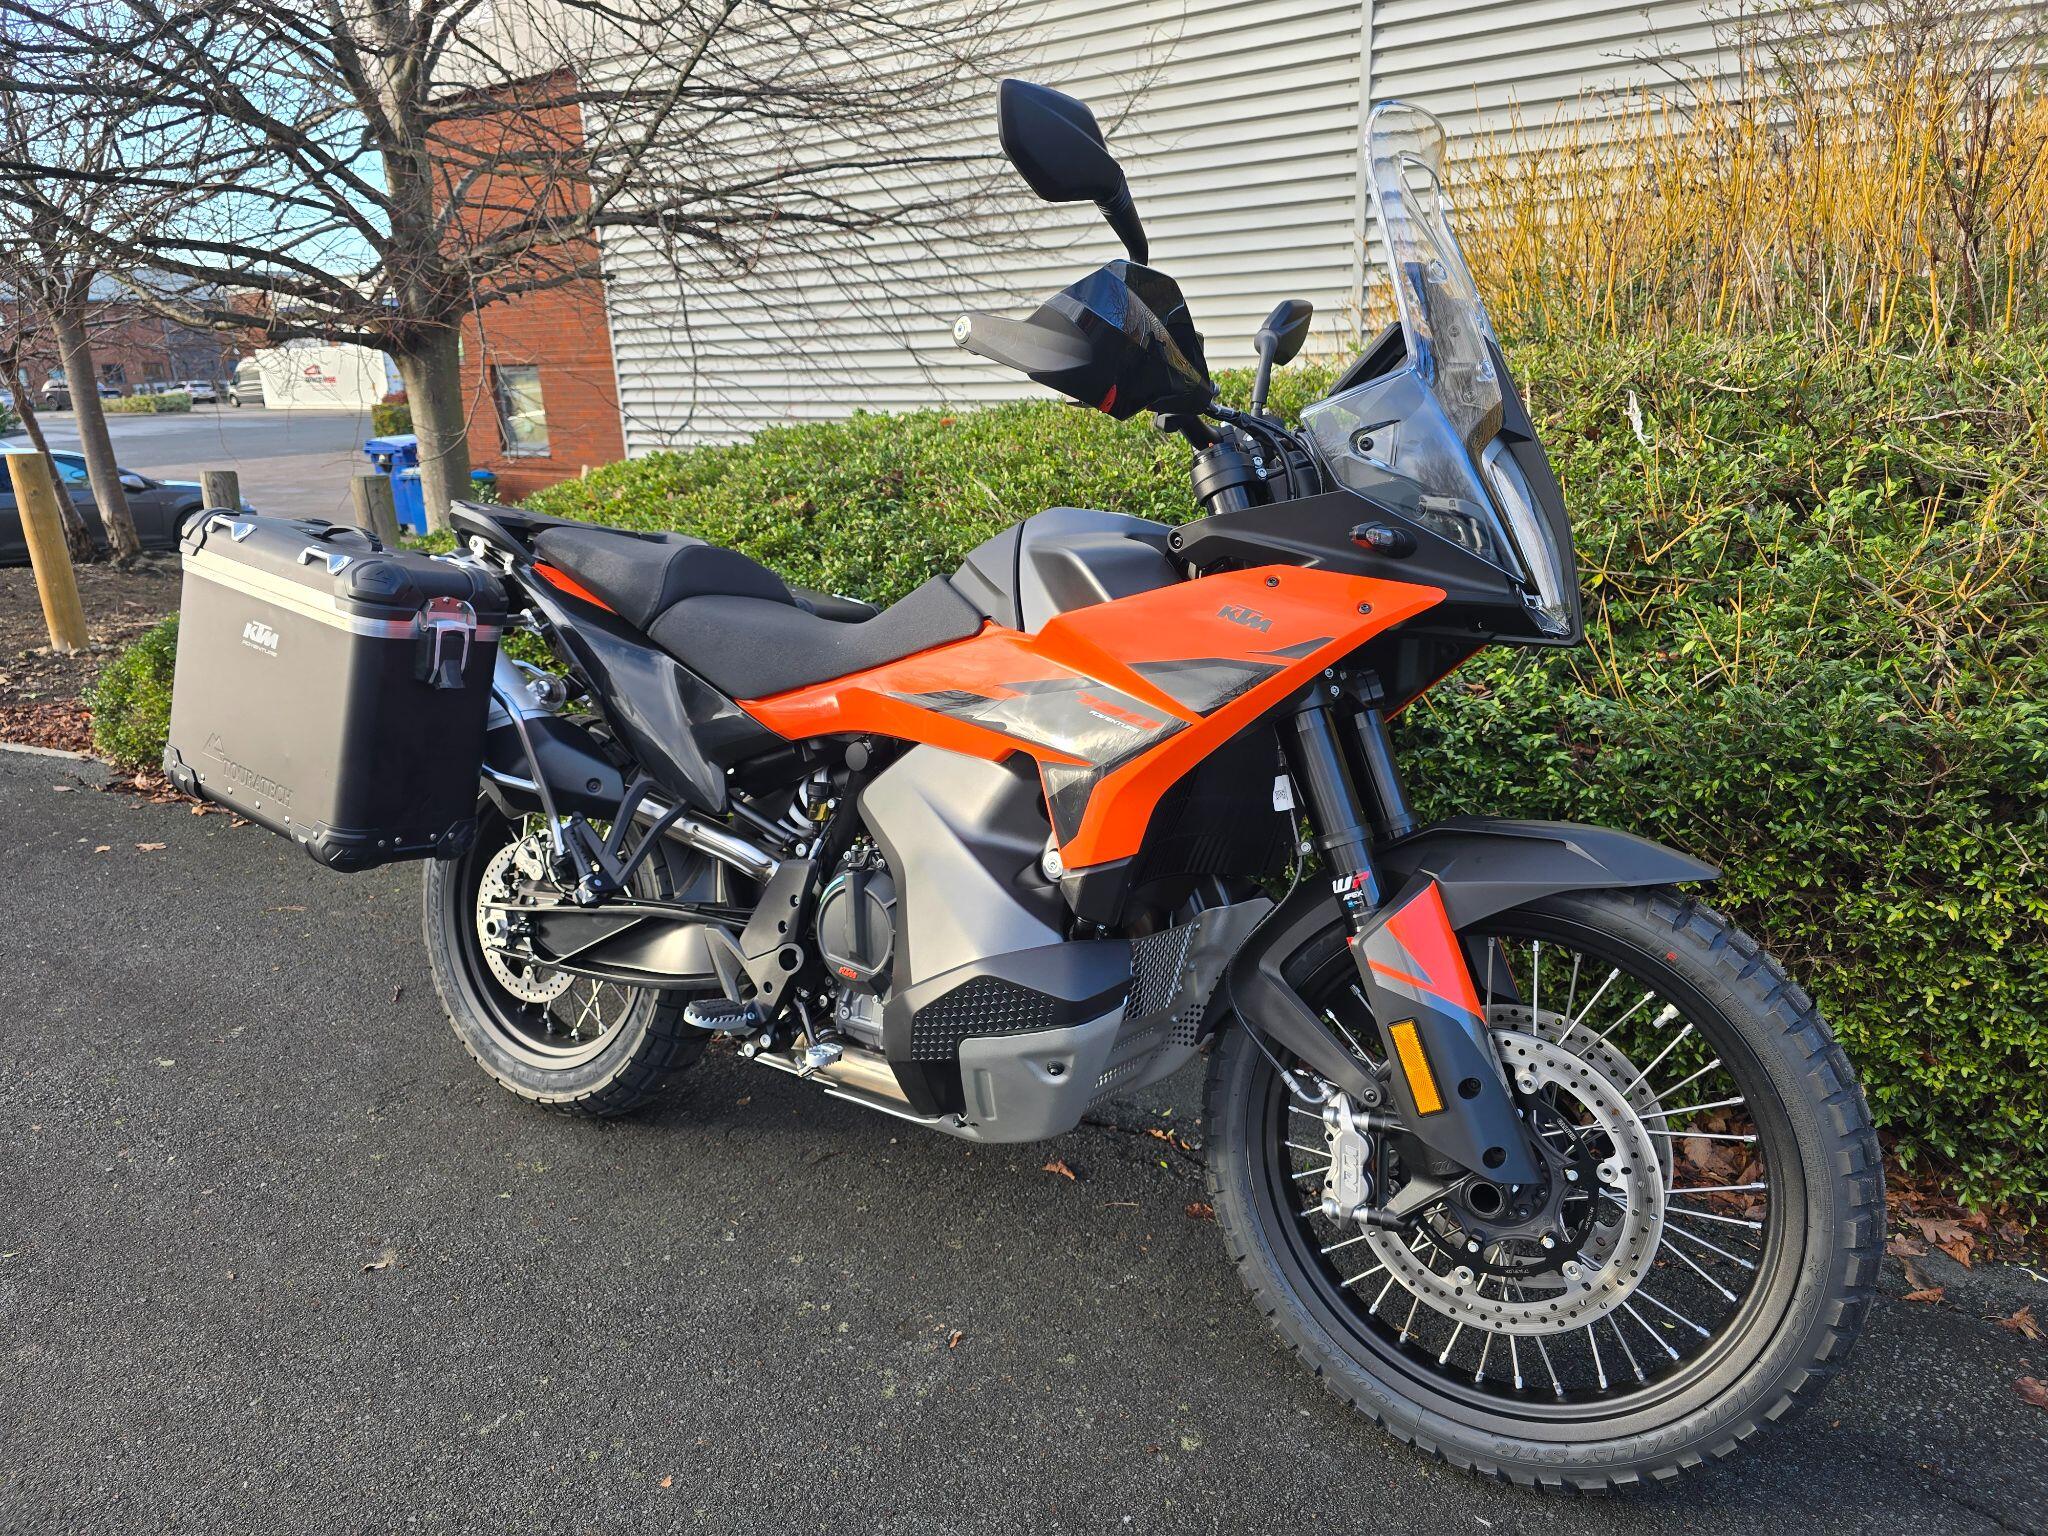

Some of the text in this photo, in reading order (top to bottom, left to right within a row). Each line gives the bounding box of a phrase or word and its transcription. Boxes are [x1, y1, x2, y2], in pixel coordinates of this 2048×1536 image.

[1217, 604, 1273, 633] KTM
[241, 639, 278, 657] ADVENTURE
[242, 620, 279, 650] KTM
[222, 757, 294, 809] TOURATECH
[1332, 870, 1370, 894] WP
[838, 966, 858, 979] KTM
[1343, 1144, 1359, 1193] KTM
[1496, 1287, 1819, 1465] SCORPION RALLY STR
